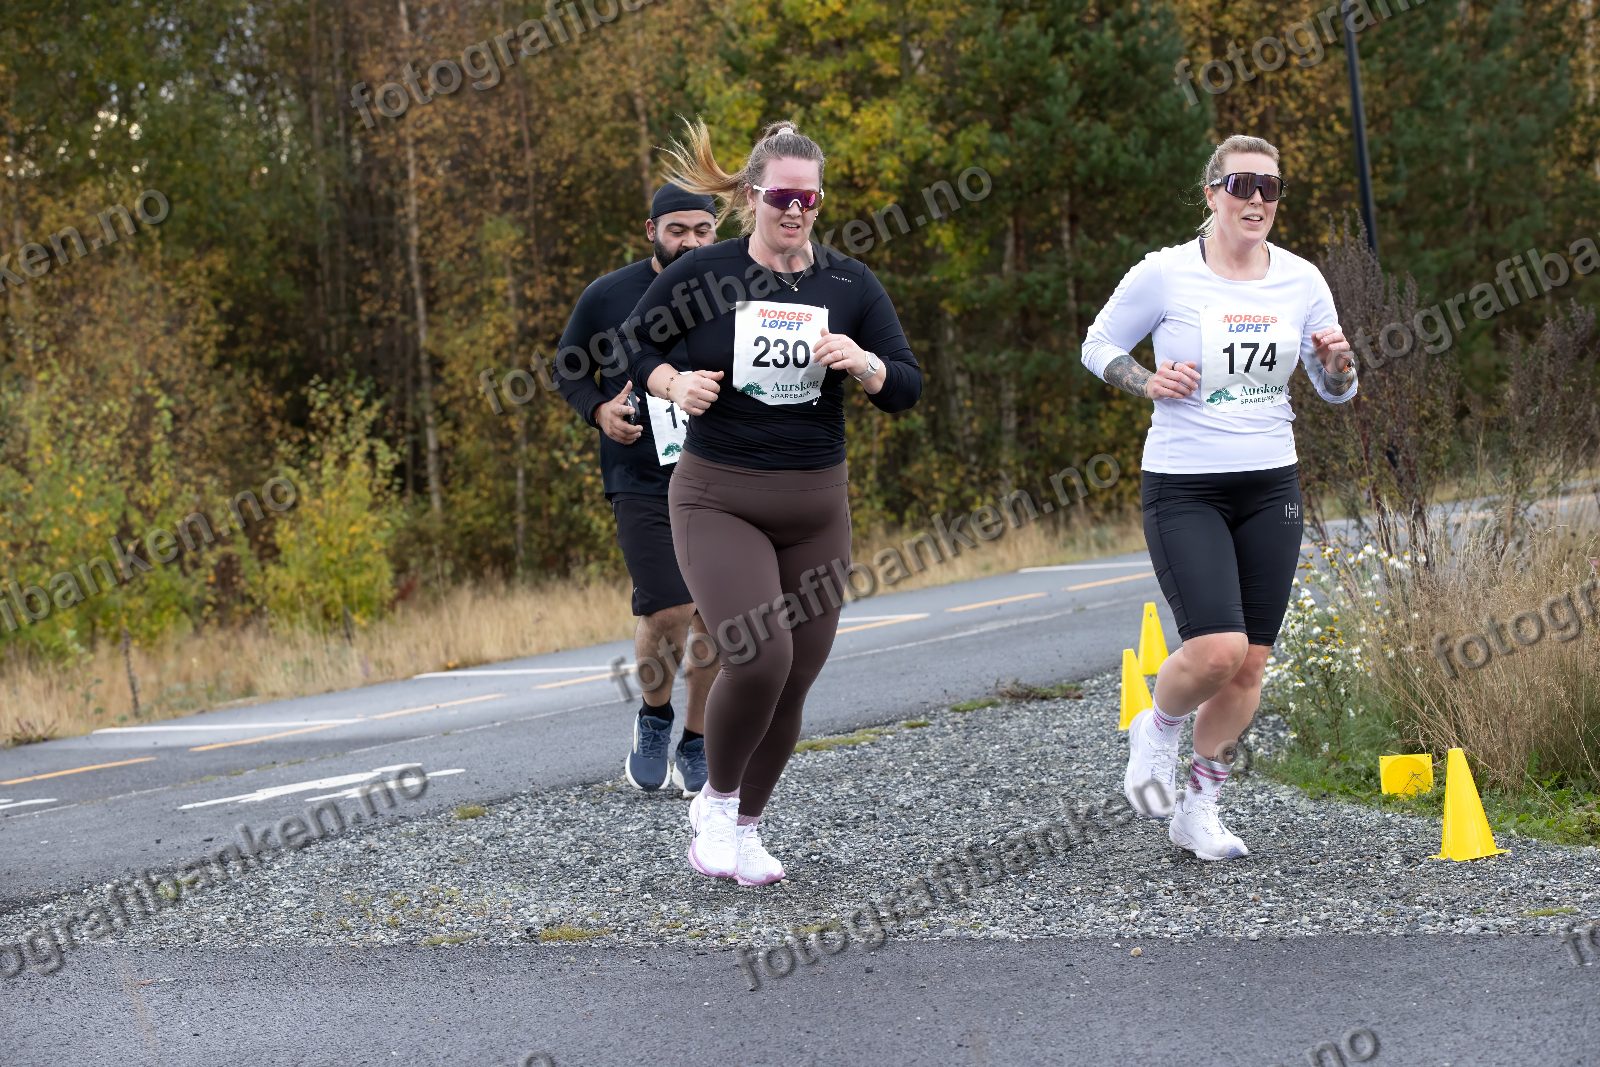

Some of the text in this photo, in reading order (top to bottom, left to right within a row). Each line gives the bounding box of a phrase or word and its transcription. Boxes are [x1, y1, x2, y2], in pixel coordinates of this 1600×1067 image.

[757, 309, 812, 322] NORGES
[1223, 314, 1278, 324] NORGES
[761, 319, 803, 331] LØPET
[1228, 323, 1270, 333] LØPET
[752, 335, 811, 369] 230
[1222, 342, 1277, 374] 174
[771, 380, 819, 392] Aurskog
[665, 403, 688, 429] 1
